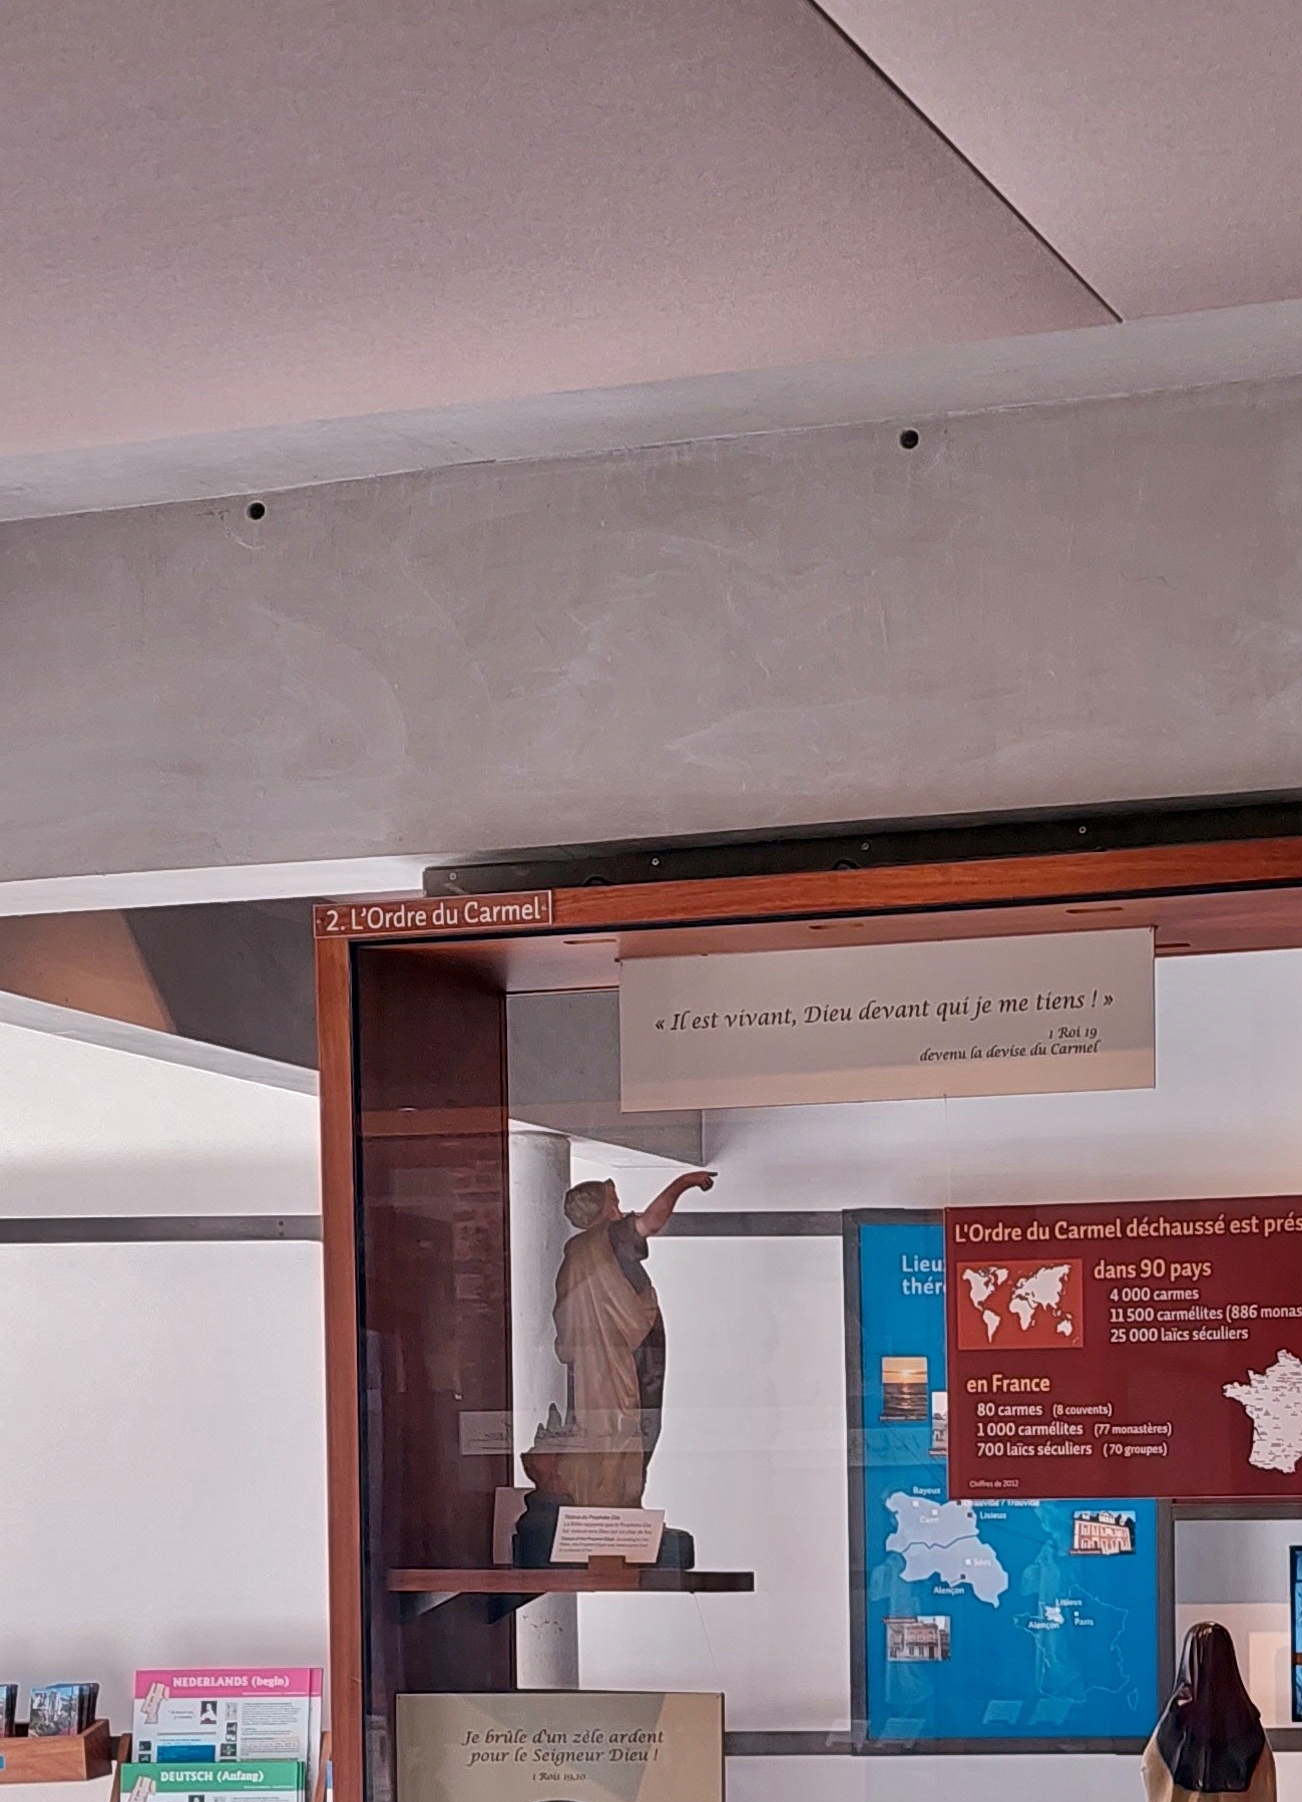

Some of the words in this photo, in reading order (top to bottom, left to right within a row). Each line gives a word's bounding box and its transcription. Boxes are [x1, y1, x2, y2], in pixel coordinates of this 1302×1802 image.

[325, 909, 345, 931] 2.
[431, 901, 458, 925] du
[463, 895, 541, 923] Carmel
[669, 1011, 690, 1031] Il
[691, 1013, 719, 1030] est
[723, 1007, 796, 1028] vivant,
[803, 1003, 852, 1023] Dieu
[858, 999, 930, 1020] devant
[935, 997, 969, 1022] qui
[971, 995, 992, 1020] je
[998, 997, 1028, 1013] me
[1035, 992, 1085, 1011] tiens
[919, 1046, 966, 1062] devenu
[969, 1044, 982, 1059] la
[985, 1043, 1026, 1058] devise
[1029, 1041, 1047, 1056] du
[1049, 1038, 1101, 1055] Carmel
[1026, 1220, 1050, 1240] du
[1054, 1217, 1122, 1239] Carmel
[1125, 1213, 1225, 1237] déchaussé
[1229, 1215, 1259, 1233] est
[902, 1255, 945, 1272] Lieu
[1093, 1259, 1136, 1279] dans
[1139, 1258, 1165, 1278] 90
[1169, 1261, 1211, 1281] pays
[902, 1276, 946, 1295] thér
[1109, 1287, 1119, 1301] 4
[1121, 1287, 1150, 1301] 000
[1152, 1288, 1199, 1301] carmes
[1109, 1307, 1124, 1322] 11
[1126, 1306, 1154, 1322] 500
[1156, 1305, 1223, 1321] carmélites
[1110, 1328, 1126, 1342] 25
[1128, 1327, 1158, 1342] 000
[1160, 1326, 1190, 1341] laïcs
[1191, 1325, 1249, 1340] séculiers
[966, 1378, 988, 1392] en
[991, 1373, 1050, 1393] France
[976, 1402, 995, 1416] 80
[997, 1404, 1043, 1416] carmes
[1064, 1402, 1112, 1417] couvents)
[986, 1422, 1016, 1436] 000
[1017, 1420, 1083, 1436] carmélites
[1111, 1421, 1172, 1437] monastères)
[976, 1442, 1004, 1456] 700
[1006, 1441, 1035, 1456] laïcs
[1036, 1440, 1092, 1455] séculiers
[1124, 1441, 1167, 1457] groupes)
[172, 1675, 248, 1687] NEDERLANDS
[250, 1675, 289, 1688] (begin)
[459, 1730, 480, 1746] Je
[484, 1728, 527, 1744] brûle
[531, 1728, 567, 1744] d'un
[571, 1727, 604, 1744] zèle
[608, 1727, 663, 1745] ardent
[465, 1751, 510, 1767] pour
[513, 1746, 527, 1762] le
[531, 1747, 605, 1767] Seigneur
[608, 1747, 648, 1762] Dieu
[160, 1770, 213, 1782] DEUTSCH
[216, 1770, 264, 1783] (Anfang)
